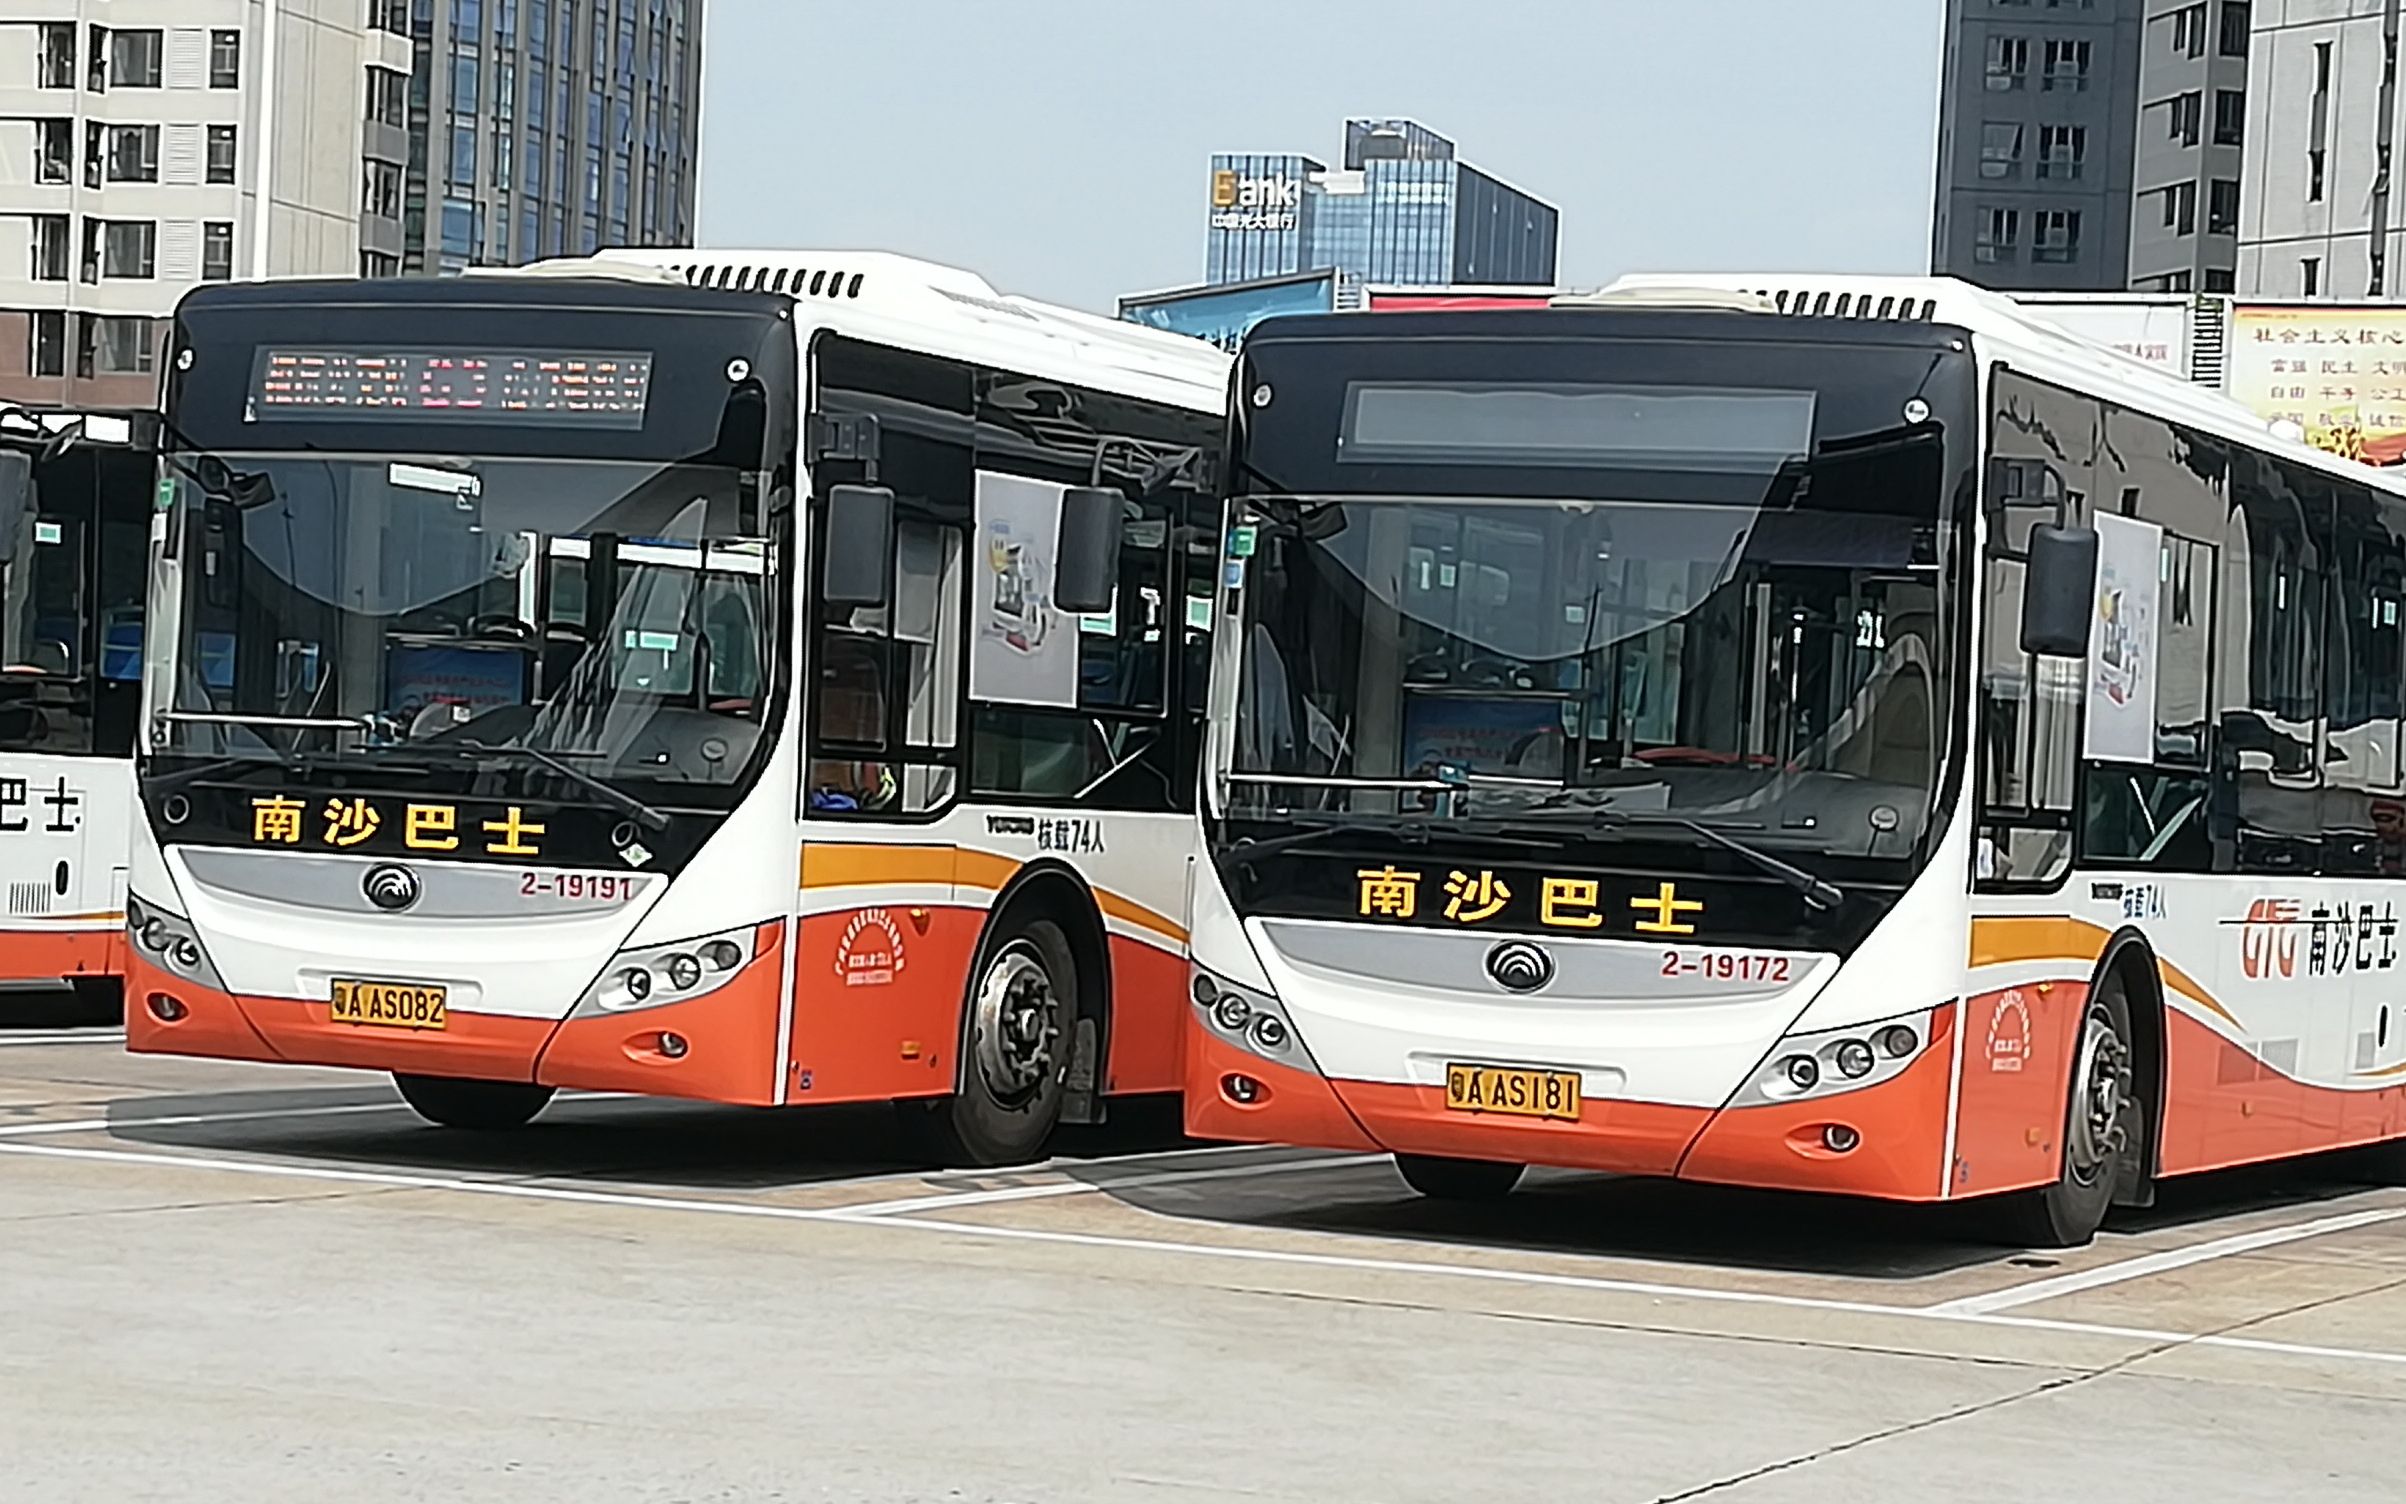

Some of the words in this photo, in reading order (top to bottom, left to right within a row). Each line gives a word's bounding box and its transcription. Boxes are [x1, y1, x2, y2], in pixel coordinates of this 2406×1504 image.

[252, 795, 545, 855] 南沙巴士
[521, 872, 633, 900] 2-19191
[1357, 865, 1703, 934] 南沙巴士
[1662, 951, 1789, 982] 2-19172
[2310, 900, 2396, 976] 南沙巴士
